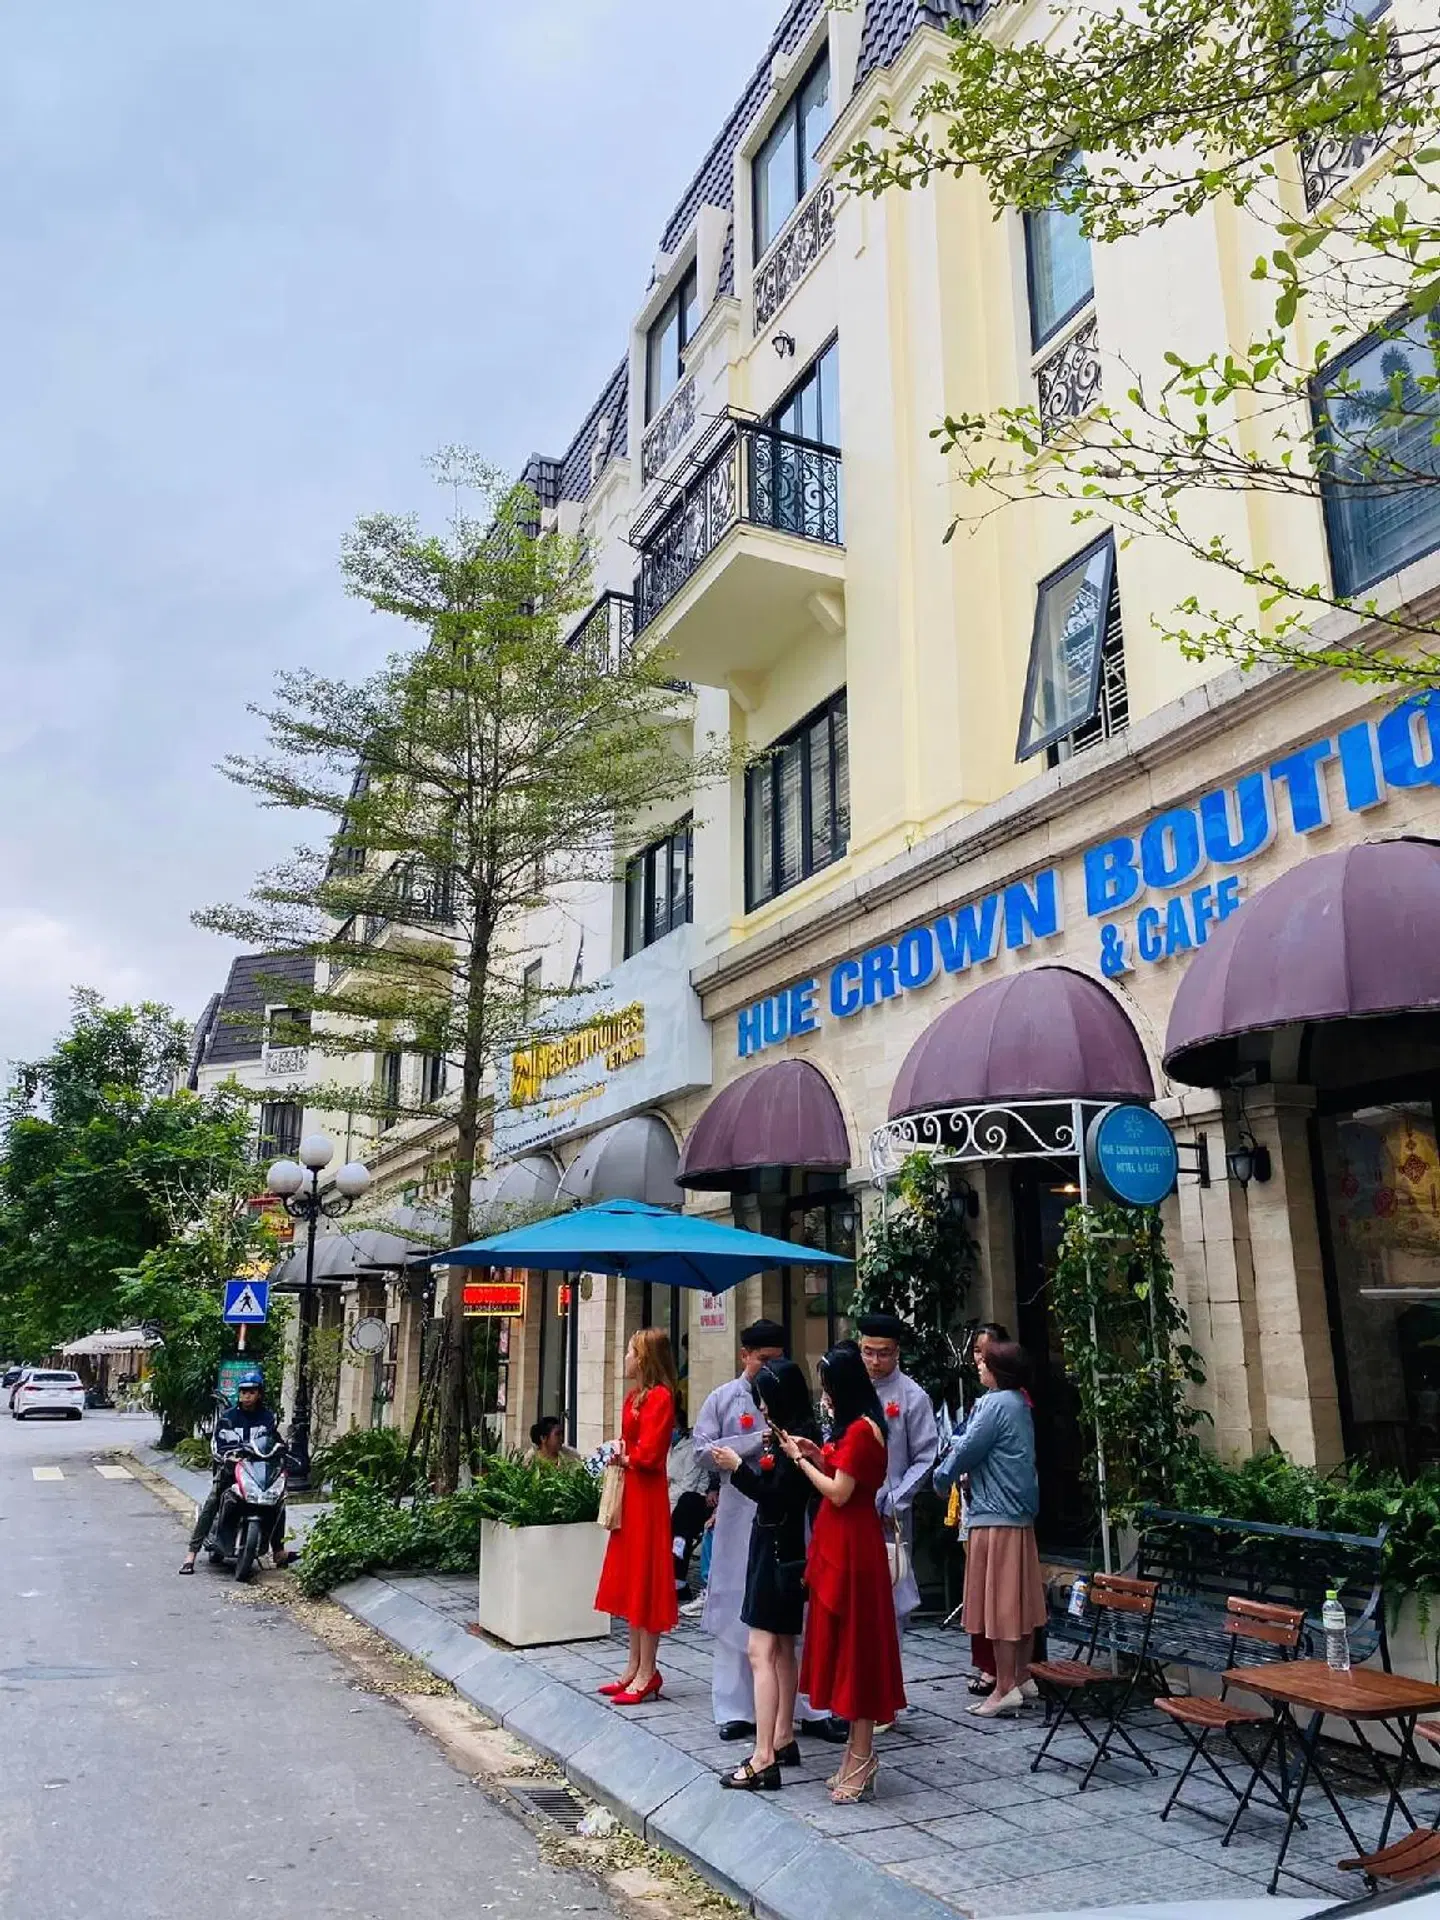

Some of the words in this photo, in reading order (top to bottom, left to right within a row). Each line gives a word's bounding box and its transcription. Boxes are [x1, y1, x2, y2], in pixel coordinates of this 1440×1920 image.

[738, 978, 822, 1057] HUE
[829, 868, 1065, 1019] CROWN
[1100, 923, 1133, 979] &
